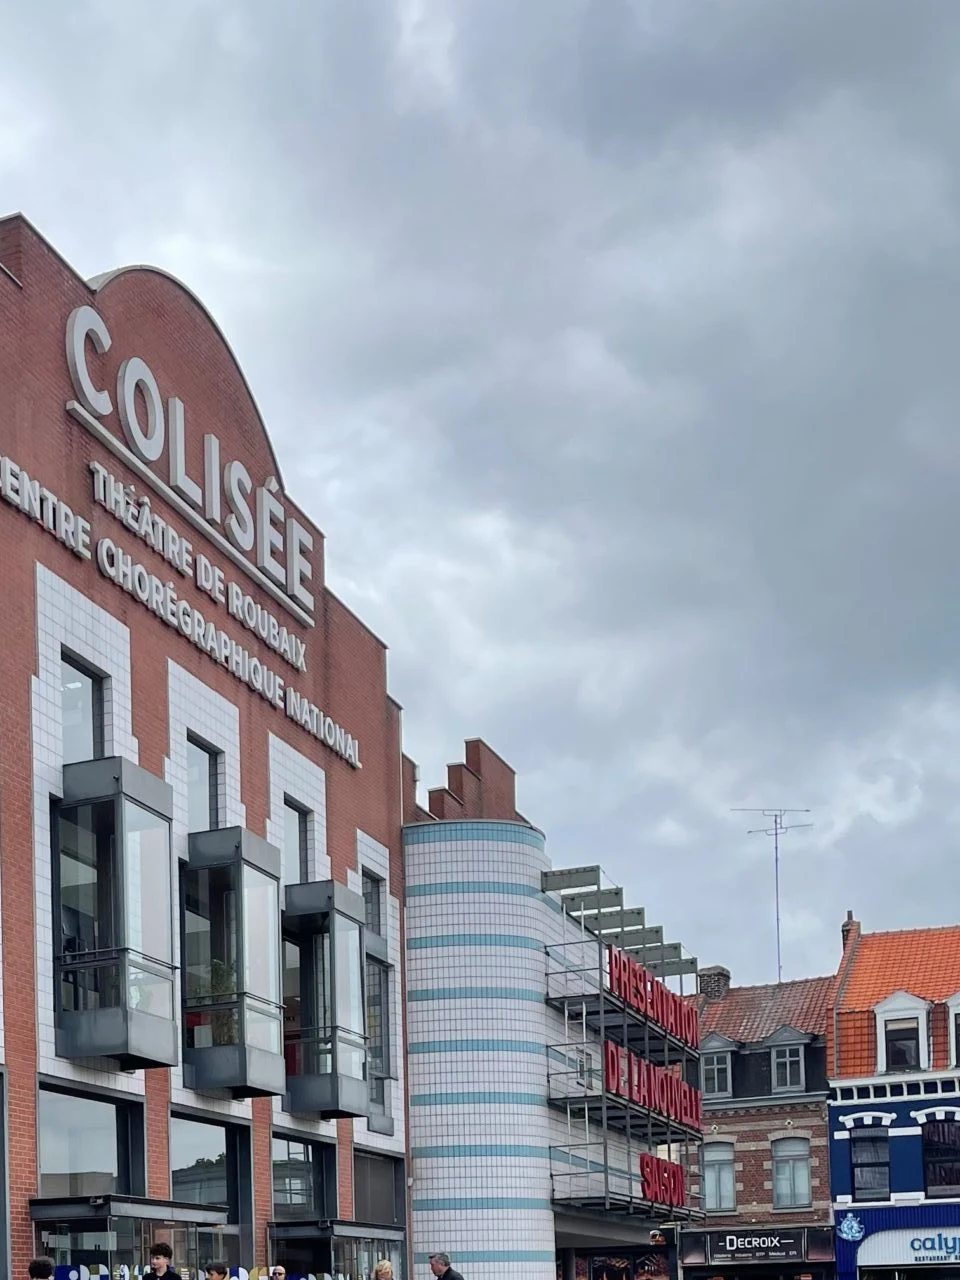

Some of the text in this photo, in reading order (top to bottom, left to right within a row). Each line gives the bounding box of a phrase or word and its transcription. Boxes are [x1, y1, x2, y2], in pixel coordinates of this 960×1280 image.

[66, 305, 315, 611] COLISÉE
[90, 462, 307, 671] THÉÂTRE DE ROUBAIX
[97, 538, 285, 708] CHORÉGRAPHIQUE
[286, 687, 362, 768] NATIONAL
[605, 1040, 629, 1099] DE
[628, 1052, 648, 1110] LA
[608, 944, 700, 1051] PRESENTATION
[640, 1153, 685, 1207] SAISON
